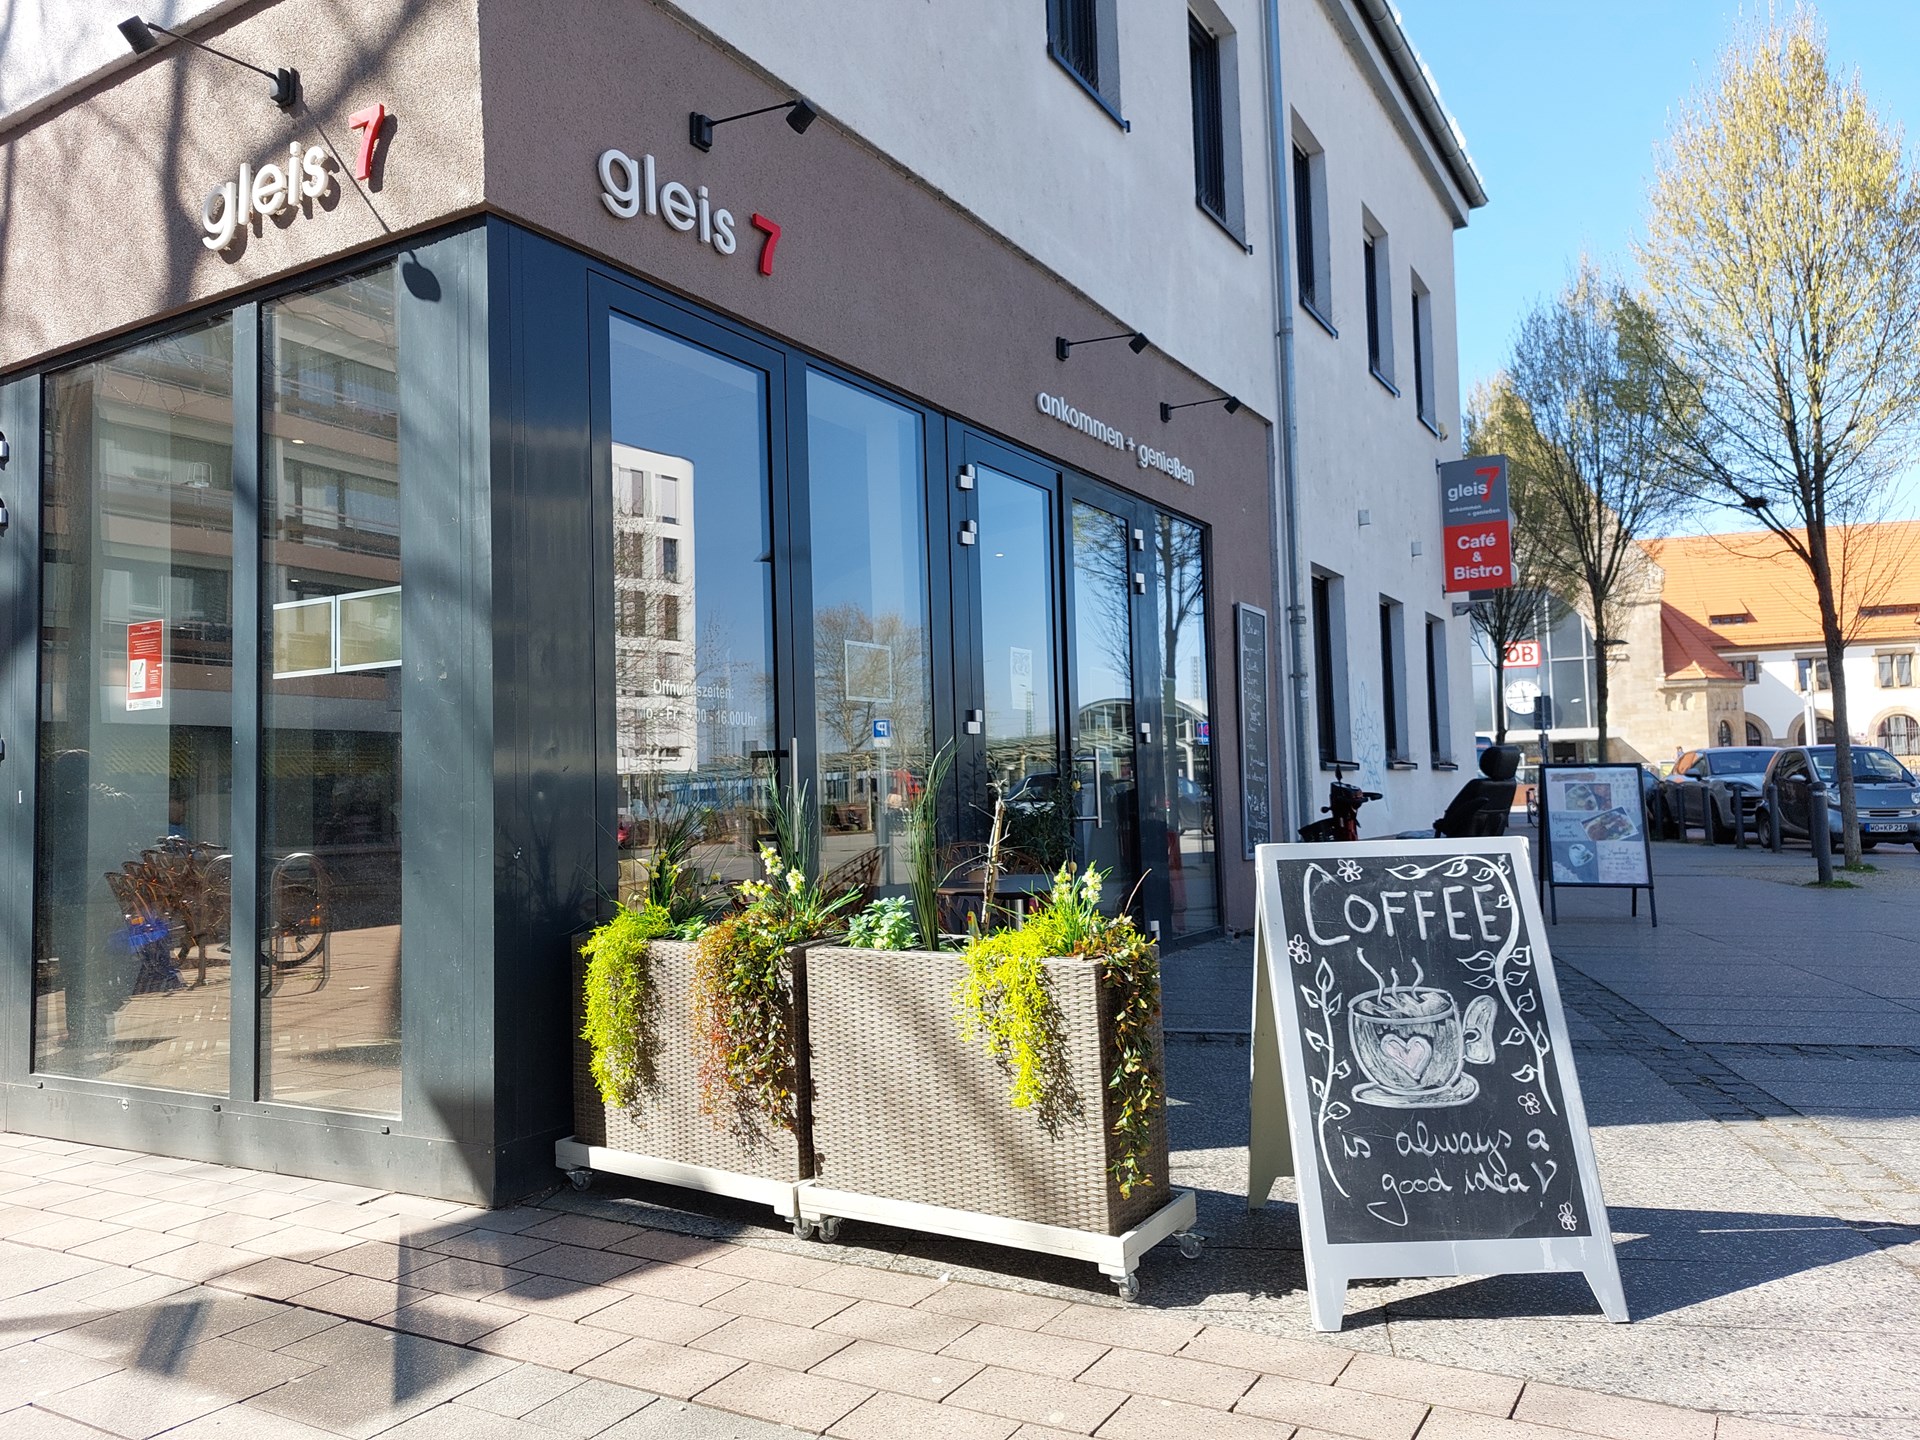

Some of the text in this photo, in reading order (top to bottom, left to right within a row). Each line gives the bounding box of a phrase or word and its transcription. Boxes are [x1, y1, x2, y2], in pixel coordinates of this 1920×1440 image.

[202, 103, 385, 250] gleis 7
[599, 149, 782, 276] gleis 7
[1037, 392, 1124, 450] ankommen
[1138, 444, 1195, 486] genießen
[1447, 466, 1500, 502] gleis 7
[1457, 532, 1496, 549] Café
[1472, 551, 1482, 562] &
[1453, 565, 1503, 580] Bistro
[1304, 863, 1500, 946] COFFEE
[1341, 1121, 1550, 1177] is always a
[1366, 1168, 1453, 1226] good
